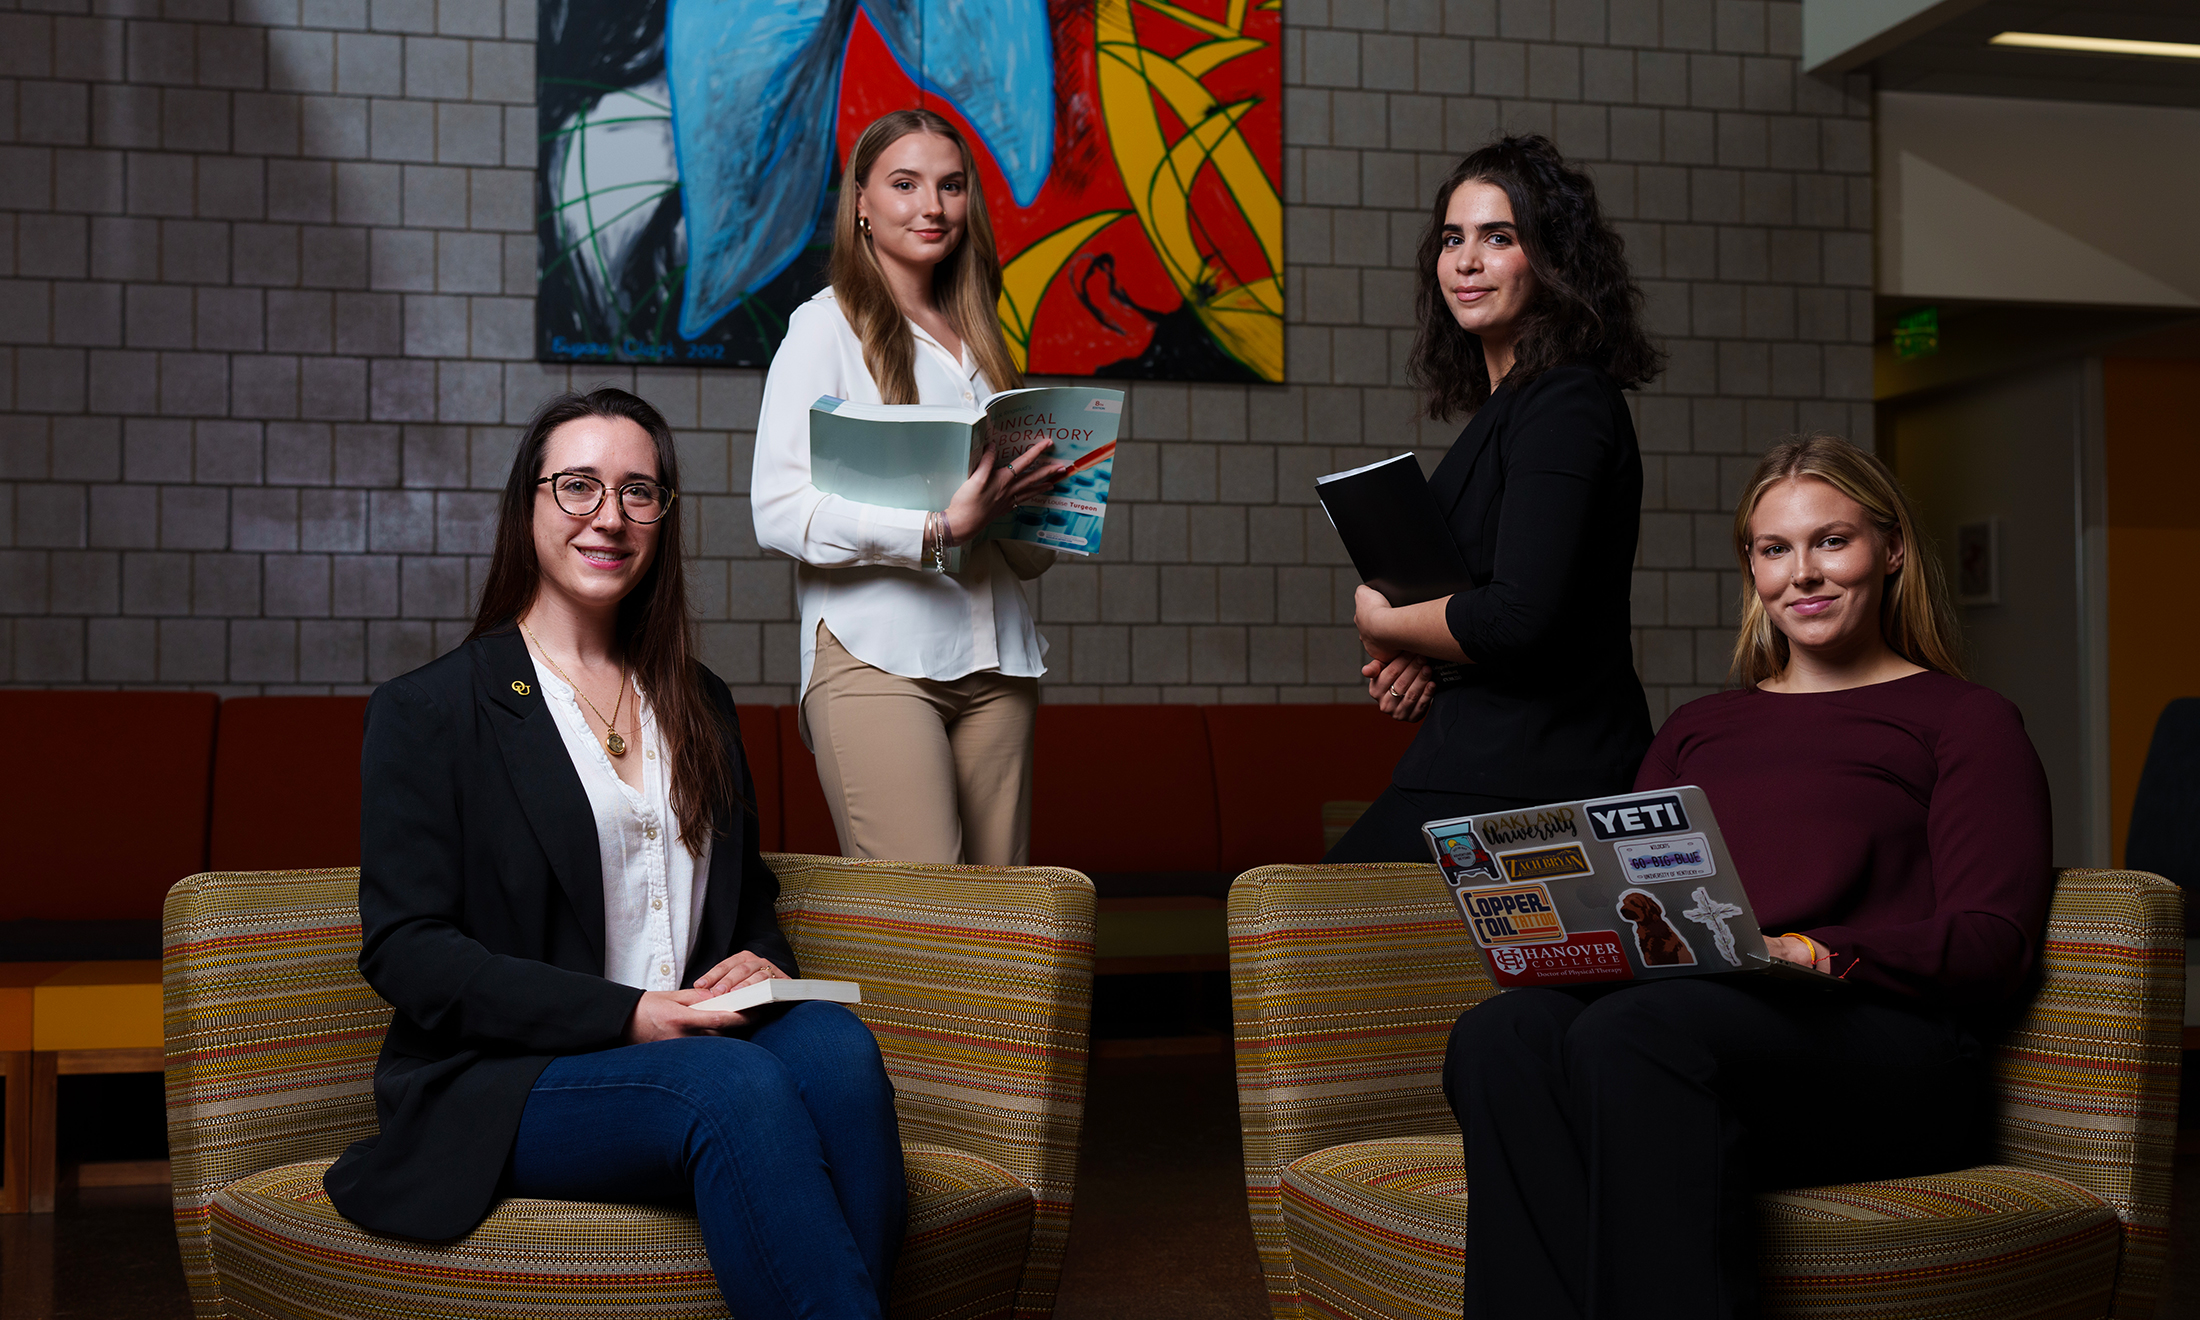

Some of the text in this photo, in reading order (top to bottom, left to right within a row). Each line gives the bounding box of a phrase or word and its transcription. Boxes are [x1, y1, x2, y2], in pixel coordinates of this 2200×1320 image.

[687, 343, 726, 360] 2012
[984, 413, 1057, 441] CLINICAL
[992, 427, 1094, 447] BORATORY
[1047, 498, 1068, 507] Louise
[1069, 501, 1098, 512] Turgeon
[1483, 807, 1575, 834] OAKLAND
[1591, 802, 1680, 834] YETI
[1482, 816, 1577, 845] University
[1505, 859, 1542, 878] ZACH
[1542, 854, 1585, 871] BRYAN
[1643, 872, 1670, 880] UNIVERSITY
[1463, 892, 1552, 918] COPPER
[1473, 912, 1557, 944] COIL TATTOO
[1523, 942, 1621, 960] HANOVER
[1531, 955, 1621, 969] COLLEGE
[1536, 966, 1623, 978] Doctor of Physical Therapy
